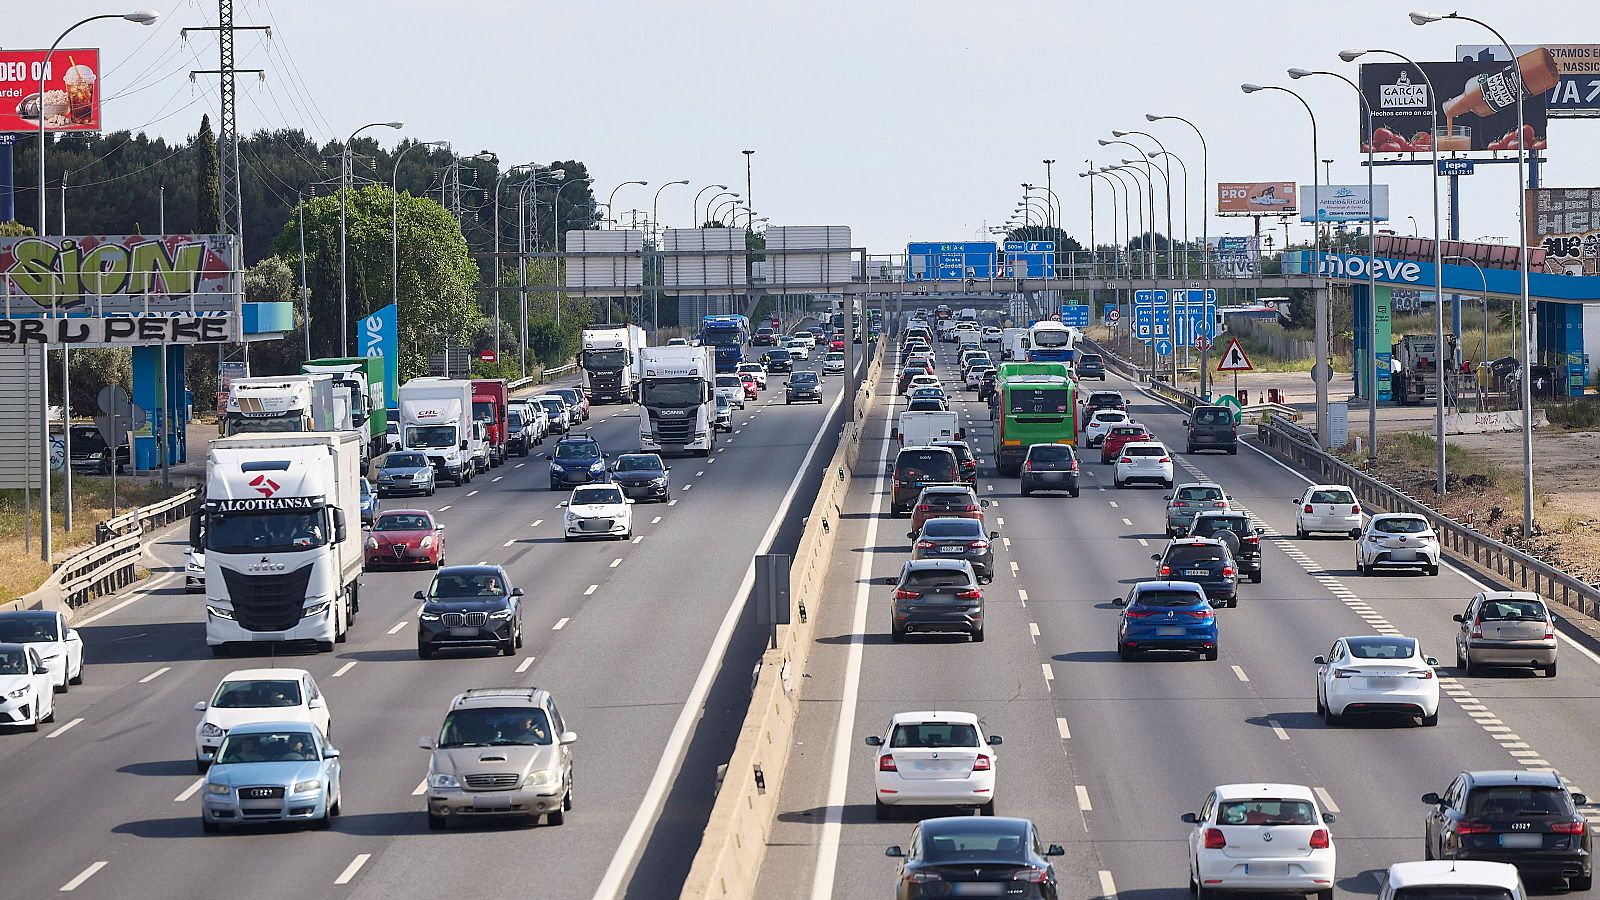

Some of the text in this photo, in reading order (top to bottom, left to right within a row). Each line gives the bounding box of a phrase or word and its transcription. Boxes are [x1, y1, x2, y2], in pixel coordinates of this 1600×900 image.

[1548, 48, 1590, 58] STAMOS
[31, 61, 52, 81] ON
[1383, 86, 1424, 96] GARCÍA
[1383, 95, 1424, 106] MILLÁN
[1221, 189, 1247, 199] PRO
[1319, 255, 1421, 282] moeve
[104, 317, 229, 343] PEKE
[218, 498, 312, 512] ALCOTRANSA
[248, 563, 286, 572] IVECO
